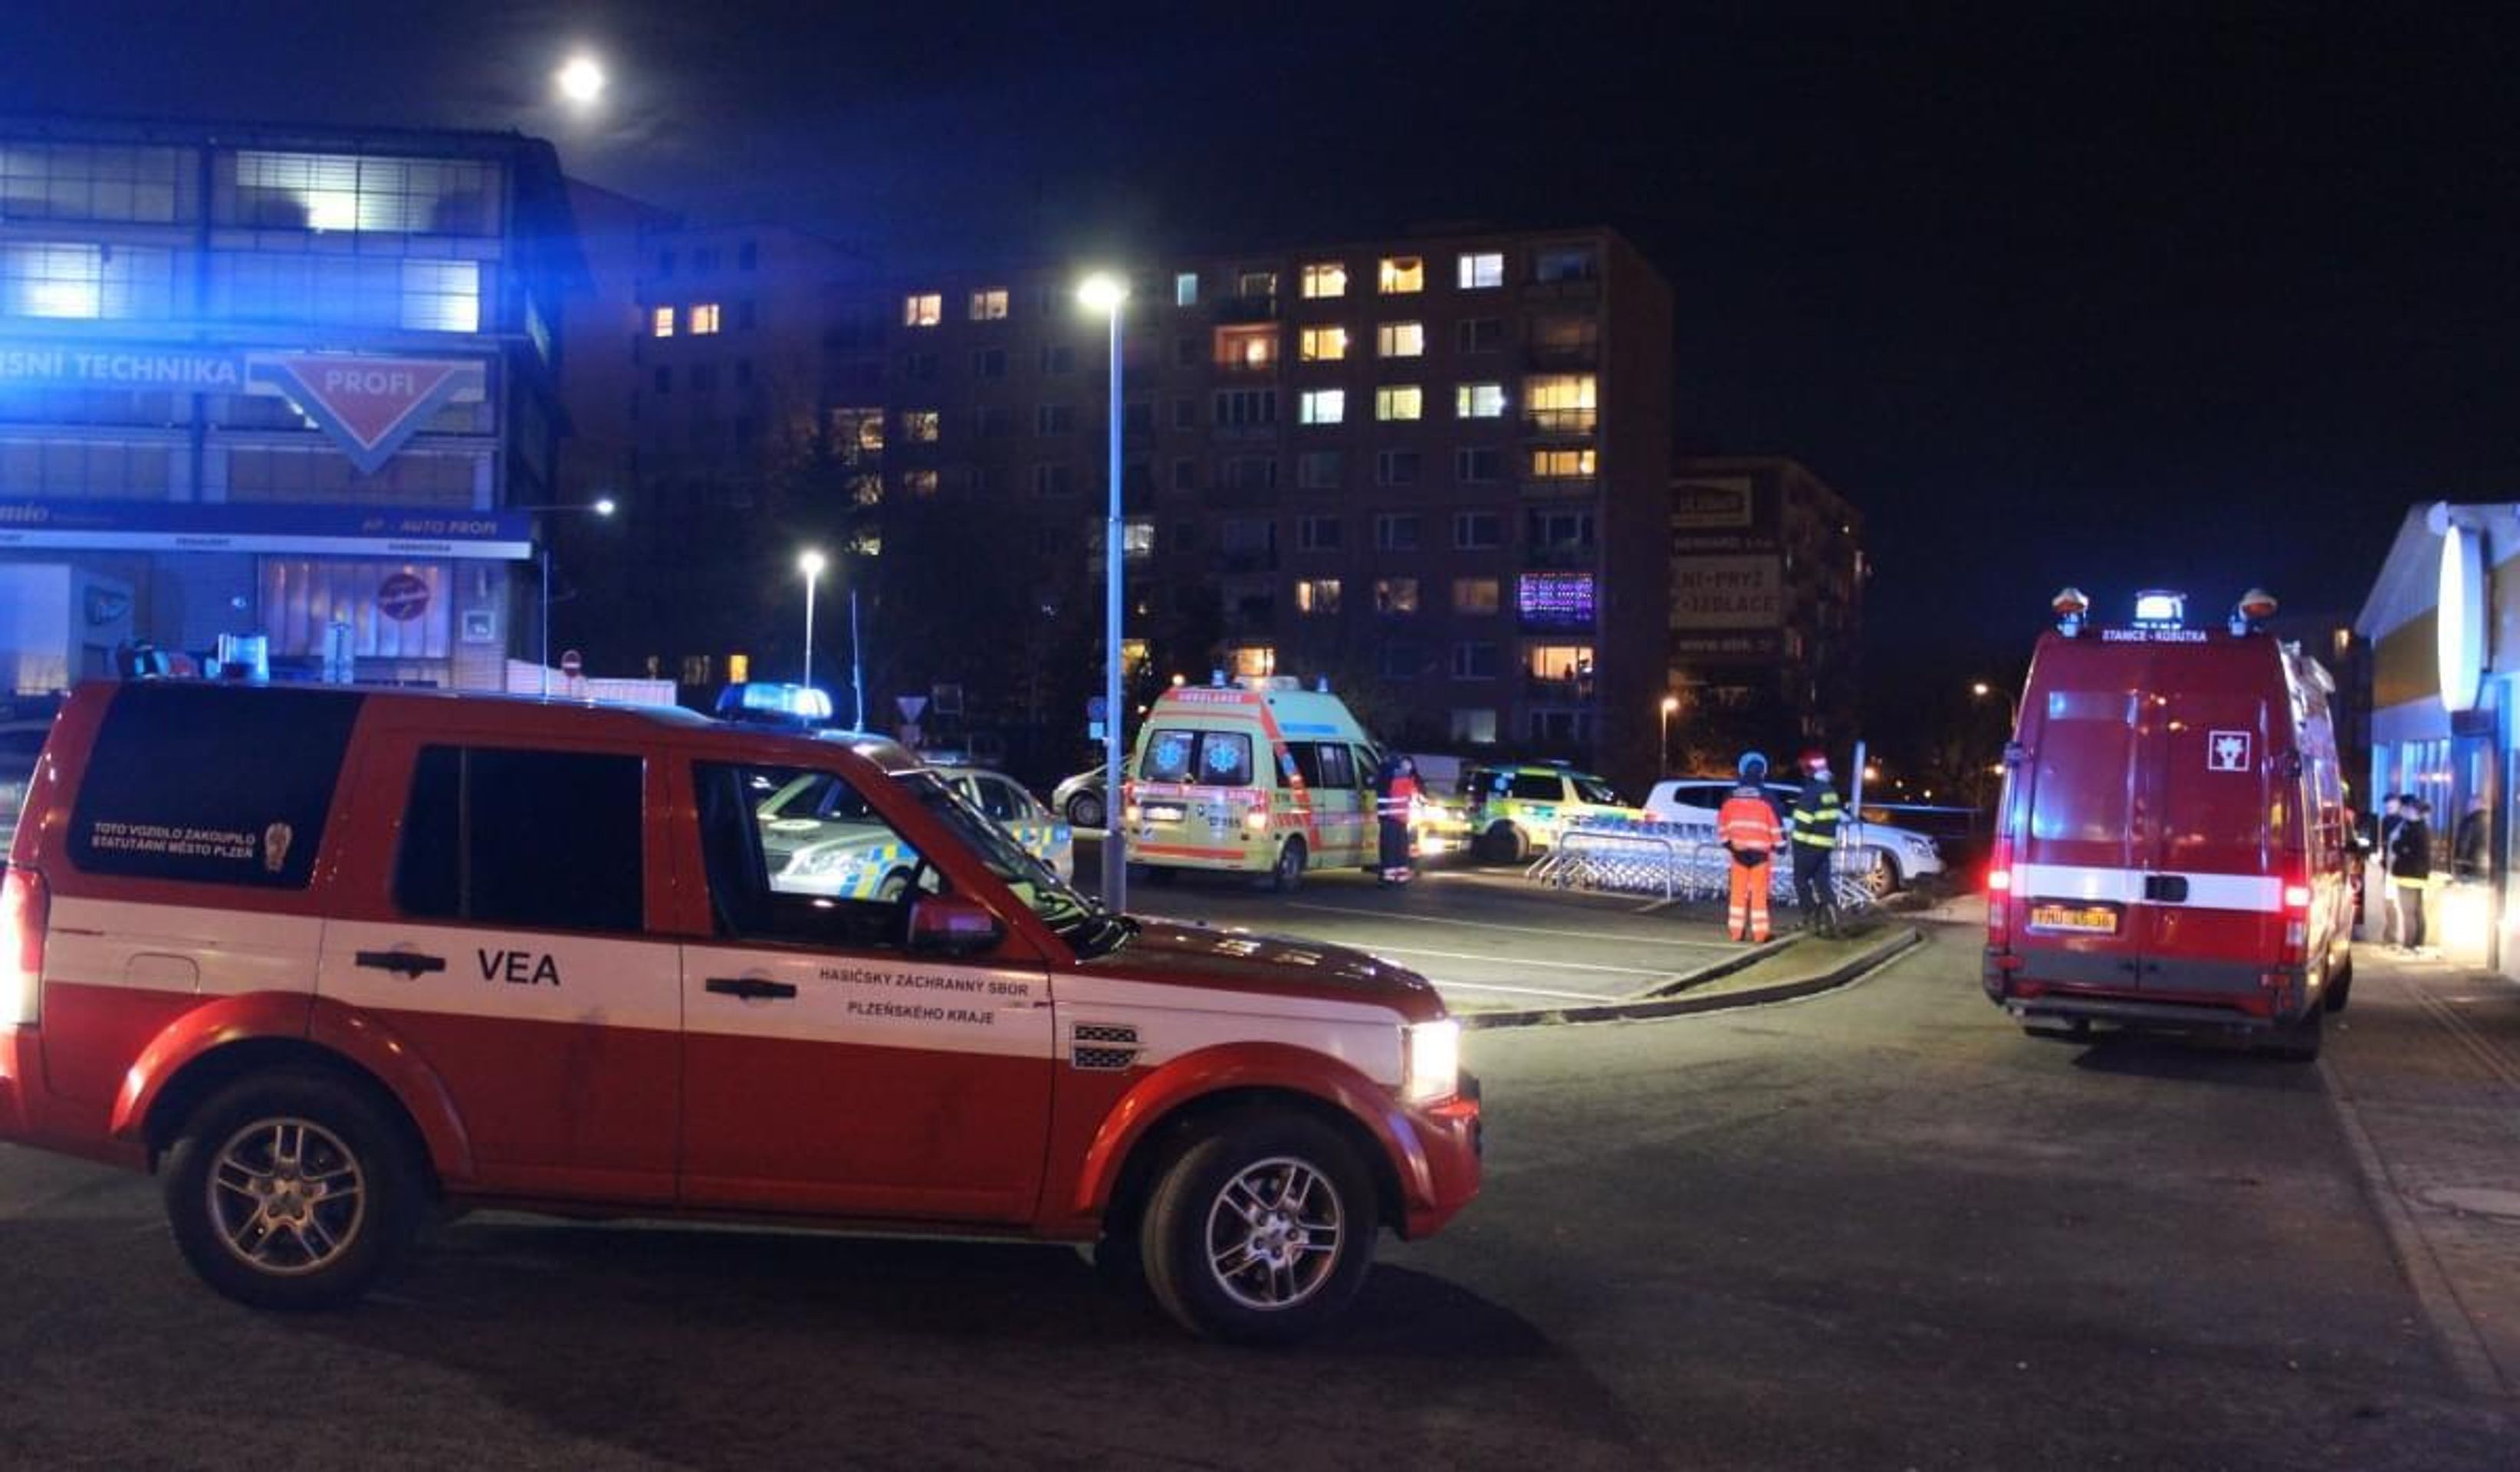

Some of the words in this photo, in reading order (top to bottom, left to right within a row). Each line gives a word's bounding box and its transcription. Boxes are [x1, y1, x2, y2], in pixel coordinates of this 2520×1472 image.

[76, 353, 237, 383] TECHNIKA
[325, 370, 414, 396] PROFI
[401, 519, 444, 534] AUTO
[448, 520, 497, 535] PROFI
[94, 823, 126, 836] TOTO
[130, 825, 182, 840] VOZIDLO
[185, 828, 255, 845] ZAKOUPILO
[478, 948, 560, 986] VEA
[987, 982, 1029, 996] SBOR
[947, 1010, 994, 1025] KRAJE
